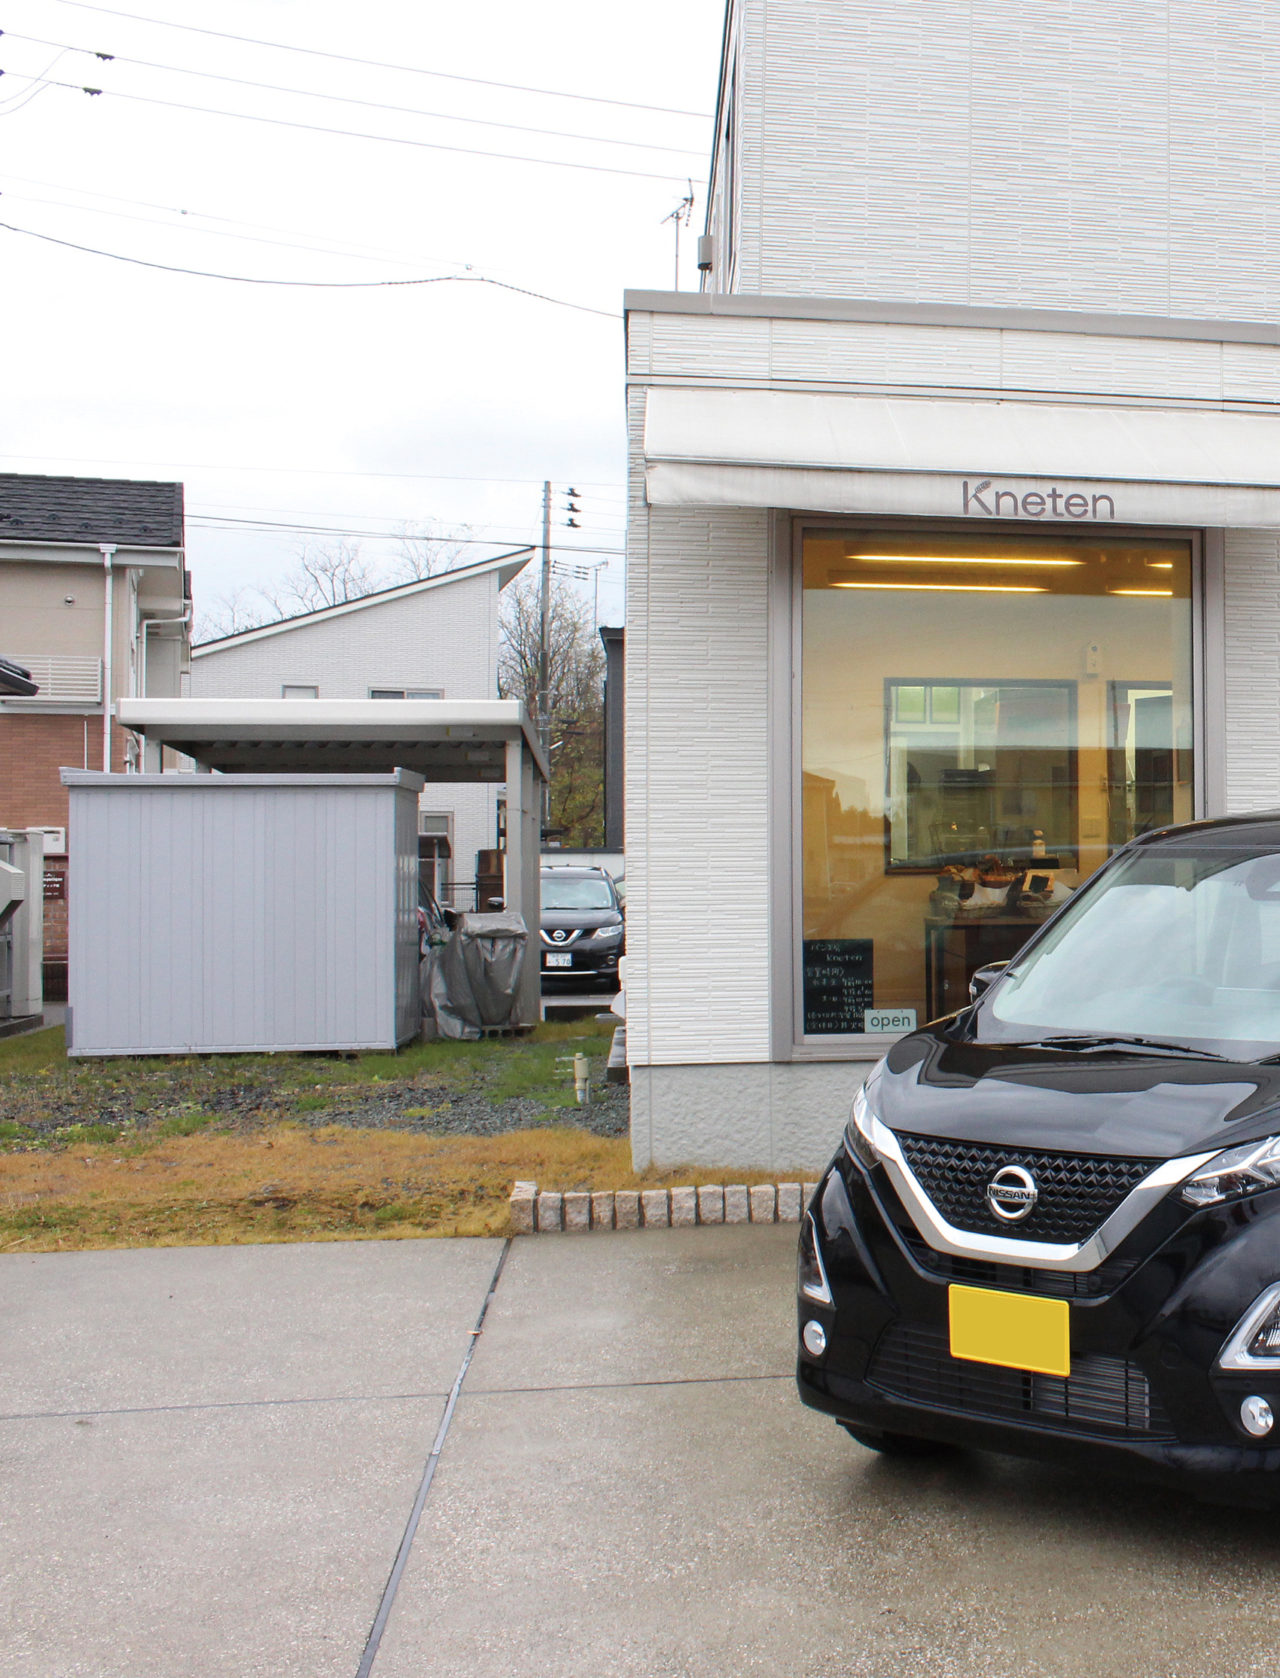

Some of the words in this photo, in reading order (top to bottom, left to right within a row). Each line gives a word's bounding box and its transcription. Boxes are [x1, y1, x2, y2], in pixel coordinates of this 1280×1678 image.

[962, 479, 1116, 520] Kneten
[870, 1015, 911, 1031] open
[988, 1188, 1031, 1200] NISSAN
